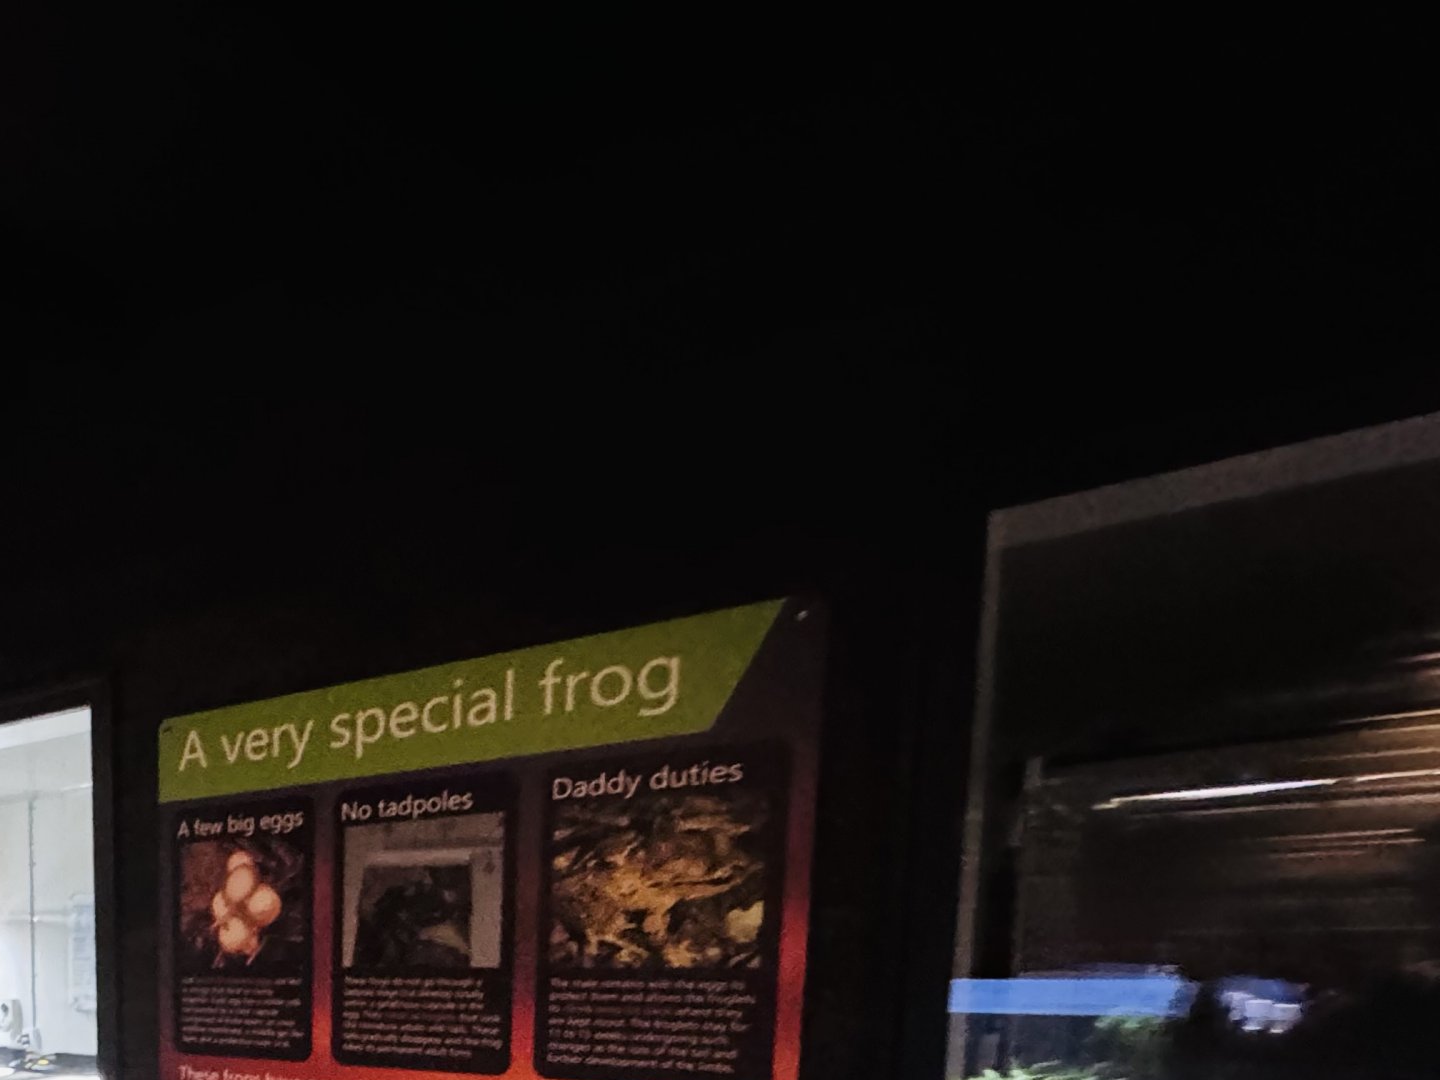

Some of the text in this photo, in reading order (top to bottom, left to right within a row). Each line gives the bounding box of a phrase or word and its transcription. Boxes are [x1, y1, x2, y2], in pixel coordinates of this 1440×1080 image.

[179, 656, 682, 771] A very special frog
[552, 760, 743, 800] Daddy duties
[341, 790, 473, 821] No tadpoles
[177, 809, 304, 839] A few big eggs
